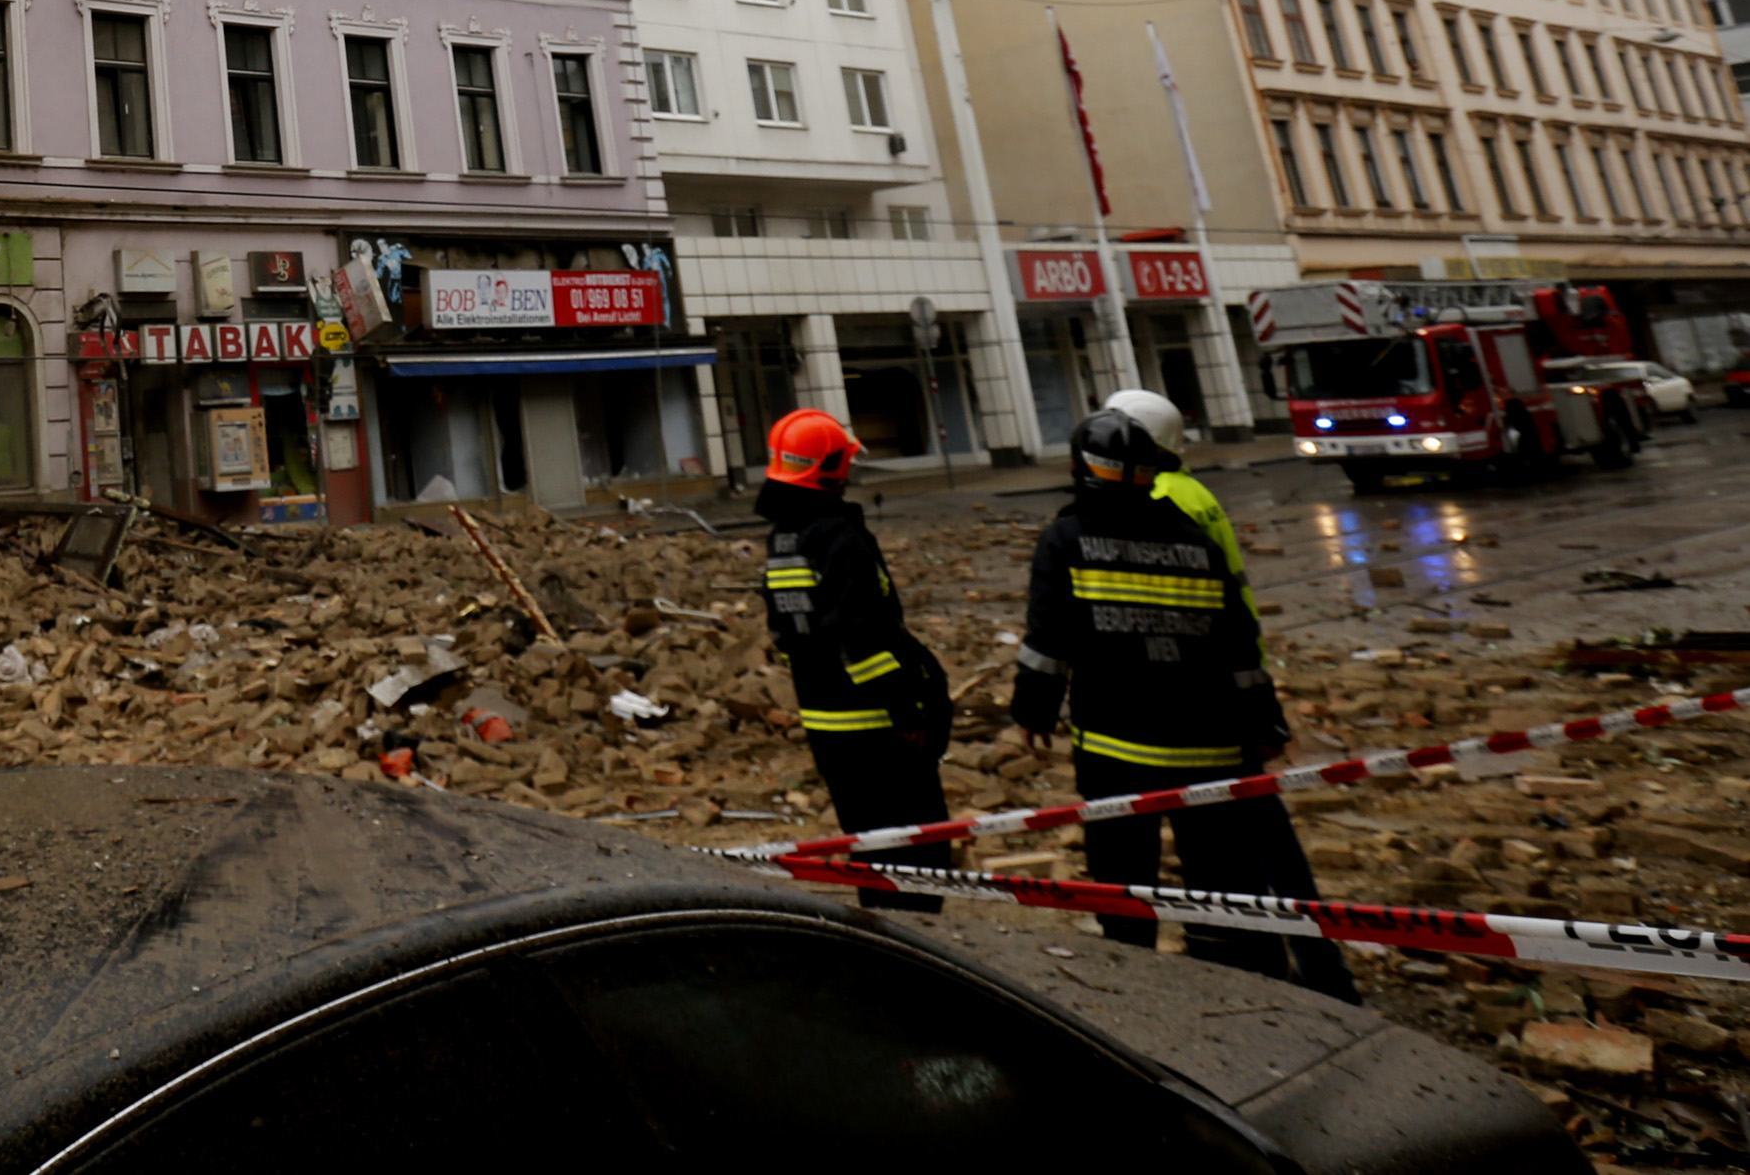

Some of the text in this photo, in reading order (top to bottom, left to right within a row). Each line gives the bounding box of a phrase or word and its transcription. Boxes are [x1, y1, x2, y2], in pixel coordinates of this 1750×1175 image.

[1034, 253, 1092, 293] ARBÖ
[1154, 260, 1205, 292] 1-2-3
[436, 289, 548, 313] BOB BEN
[148, 324, 311, 361] TABAK
